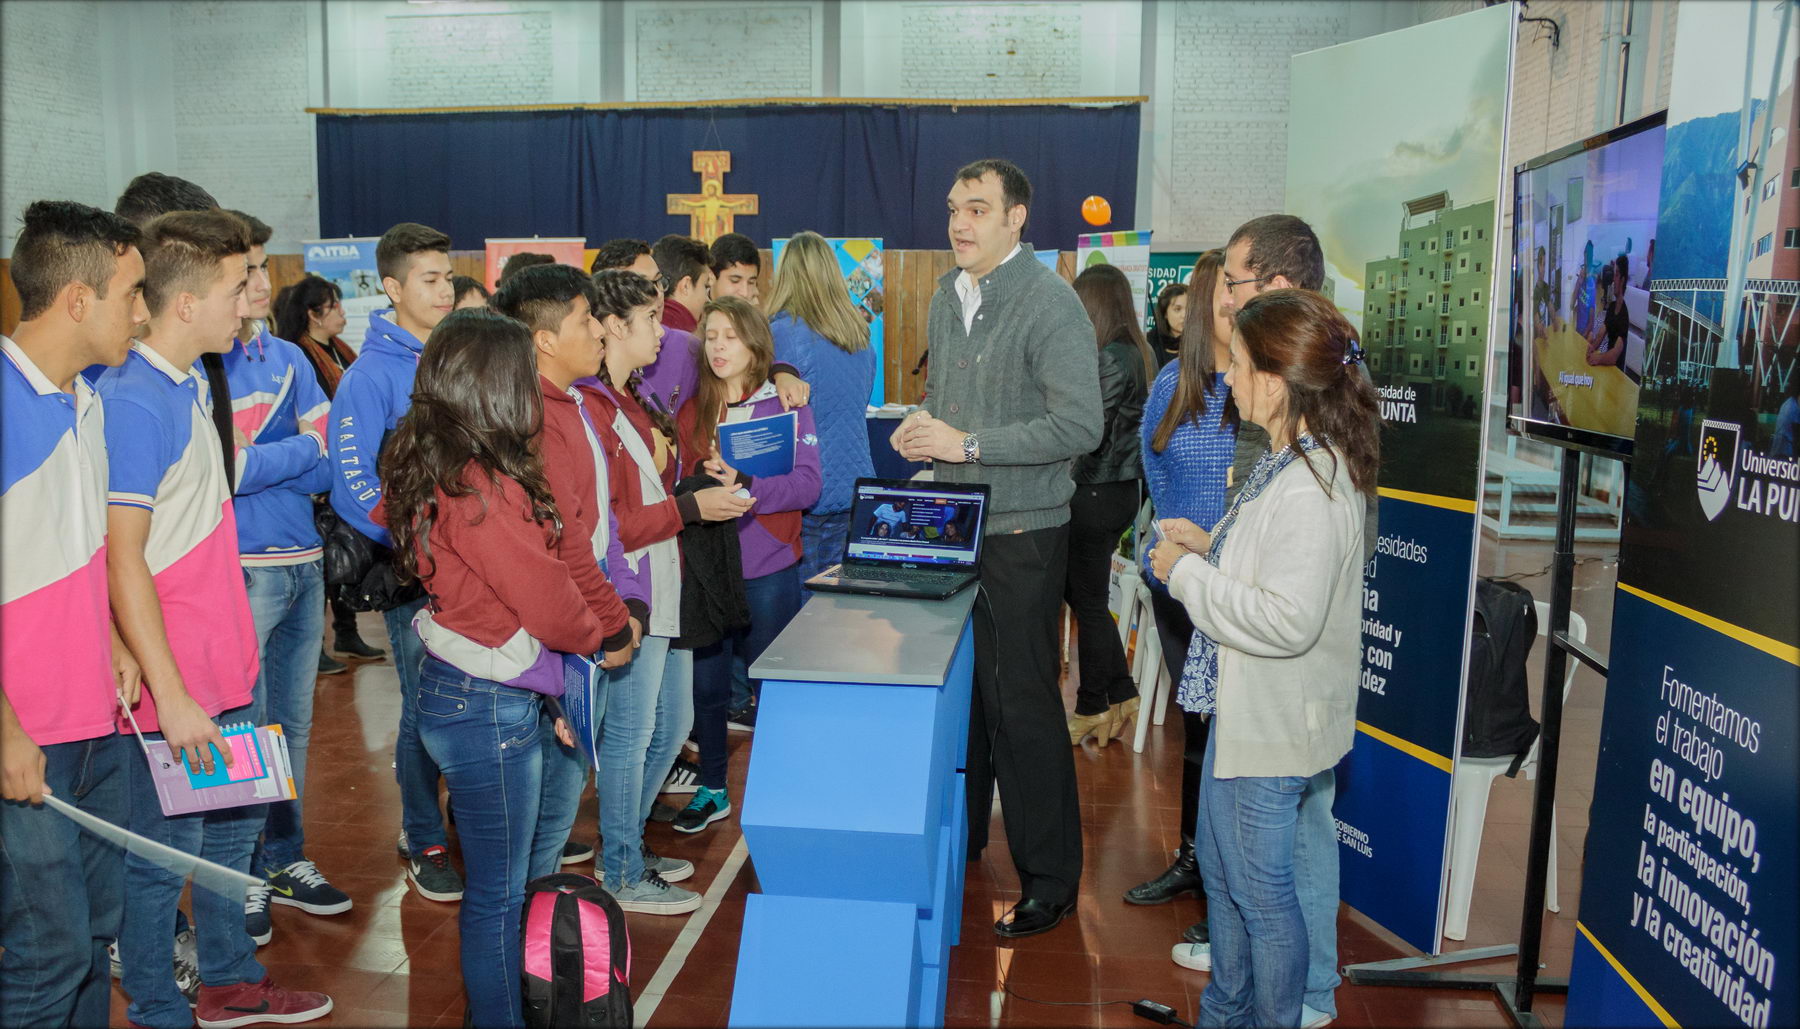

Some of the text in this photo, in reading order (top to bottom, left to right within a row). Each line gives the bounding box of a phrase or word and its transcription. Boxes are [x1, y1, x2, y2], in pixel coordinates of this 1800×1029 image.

[325, 244, 359, 257] ITBA
[1404, 386, 1417, 401] de
[1377, 400, 1417, 423] UNTA
[1737, 476, 1761, 514] LA
[1375, 533, 1428, 564] esidades
[1394, 629, 1402, 648] y
[1367, 645, 1393, 671] con
[1661, 664, 1761, 754] Fomentamos
[1656, 710, 1723, 783] el trabajo
[1650, 758, 1761, 874] en equipo,
[1342, 833, 1357, 850] SAN
[1357, 841, 1373, 858] LUIS
[1643, 803, 1751, 916] la participación,
[1637, 840, 1775, 991] la innovación
[1630, 892, 1771, 1029] y la creatividad
